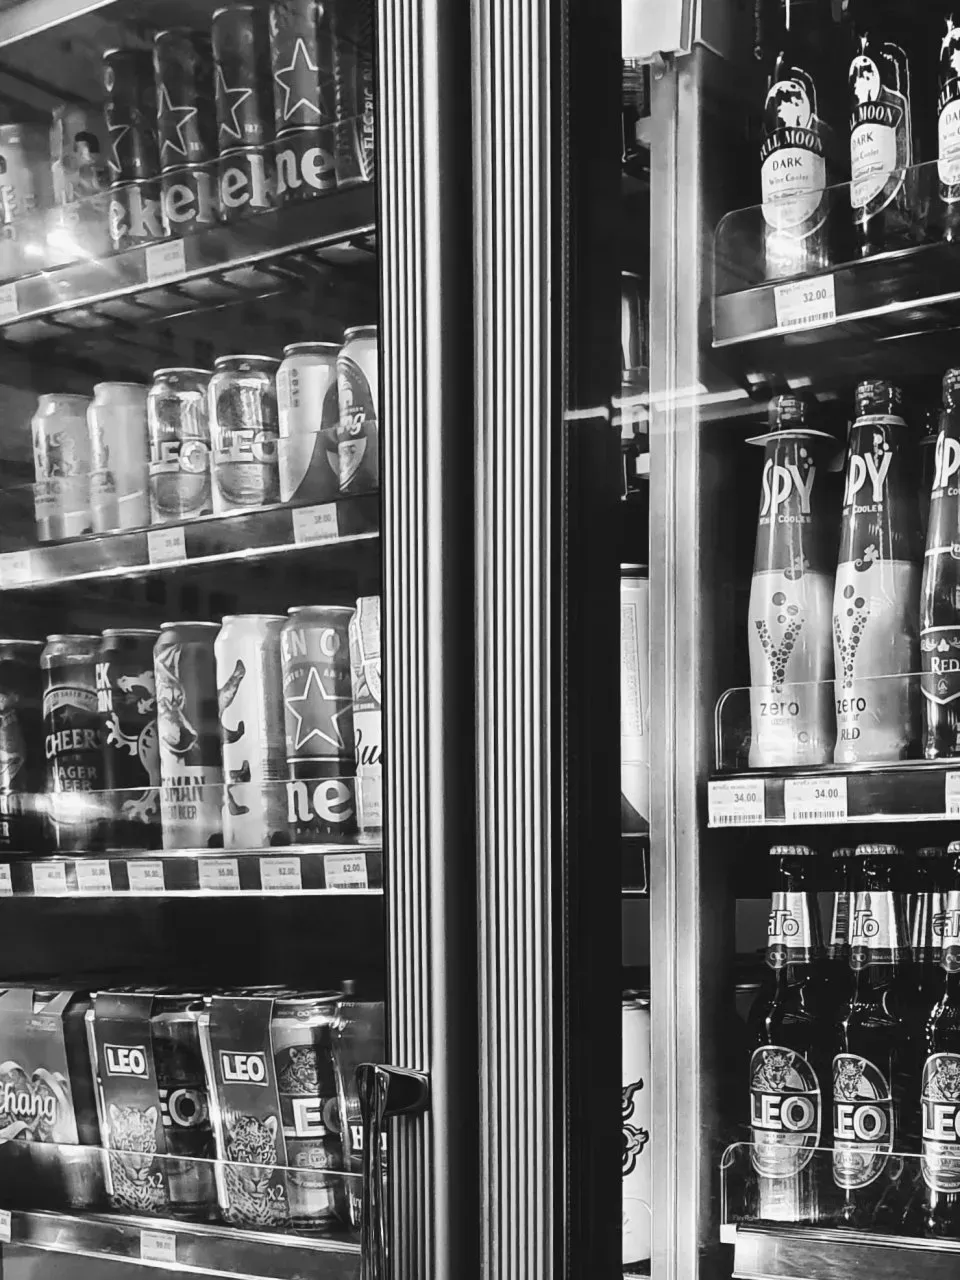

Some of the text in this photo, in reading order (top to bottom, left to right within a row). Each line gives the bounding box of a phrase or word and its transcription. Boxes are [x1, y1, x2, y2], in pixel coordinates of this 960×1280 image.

[858, 105, 894, 123] MOON
[784, 129, 823, 151] MOON
[772, 156, 804, 171] DARK
[803, 288, 828, 304] 32.00
[761, 457, 817, 517] SPY
[852, 503, 884, 514] COOLER
[930, 656, 960, 676] RED
[760, 700, 800, 717] zero
[836, 695, 867, 713] zero
[52, 766, 98, 781] LAGER
[814, 788, 840, 799] 34.00
[108, 1046, 146, 1075] LEO
[223, 1054, 266, 1082] LEO
[750, 1095, 814, 1131] LEO
[147, 1173, 164, 1190] x2
[267, 1185, 286, 1202] x2
